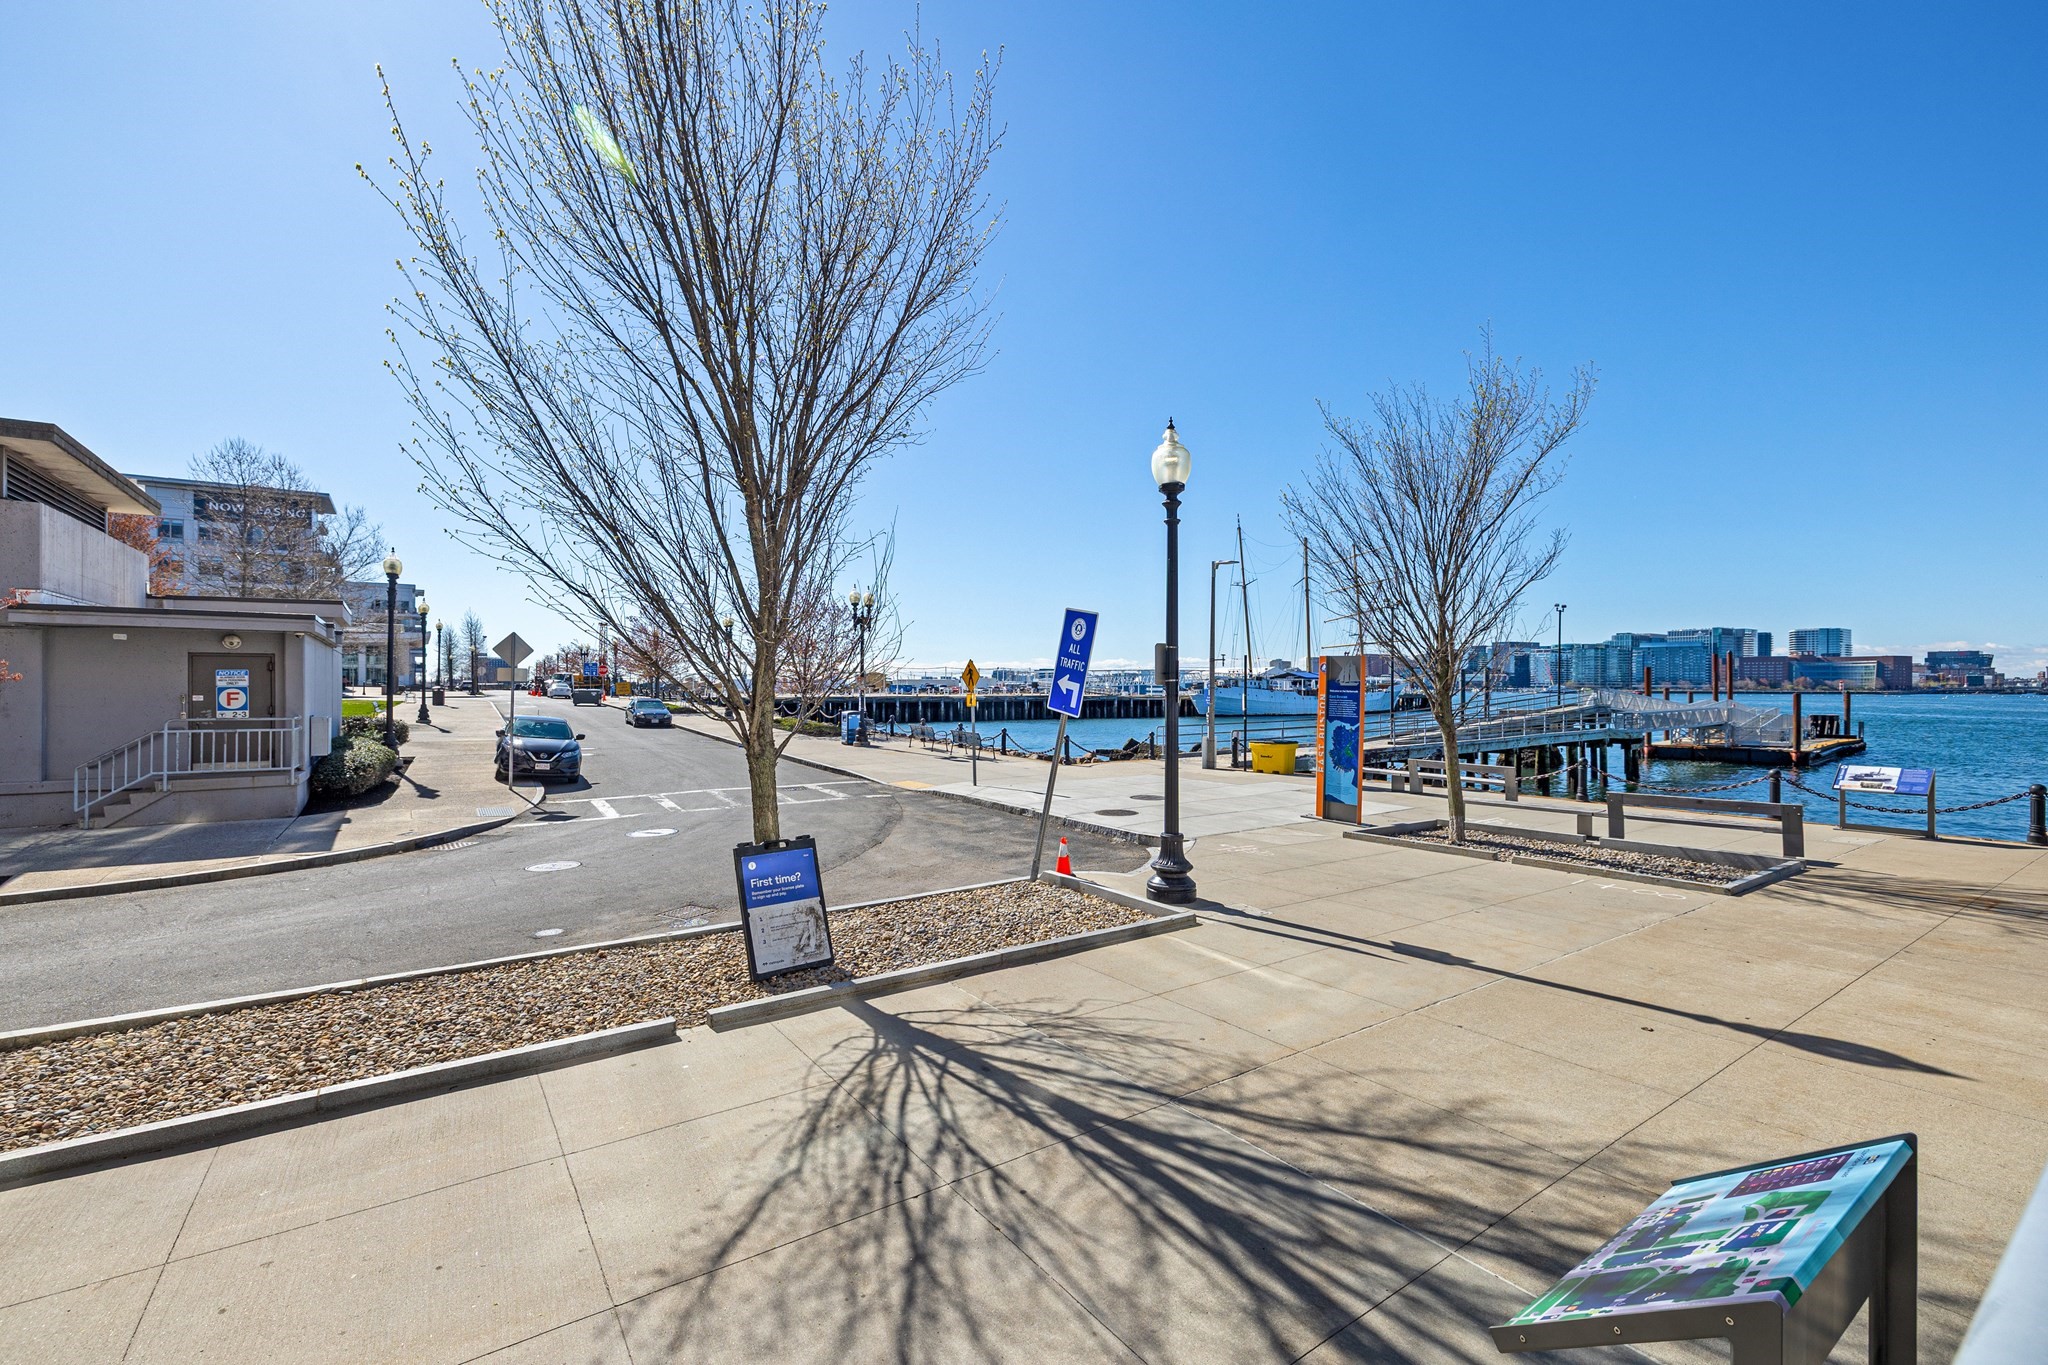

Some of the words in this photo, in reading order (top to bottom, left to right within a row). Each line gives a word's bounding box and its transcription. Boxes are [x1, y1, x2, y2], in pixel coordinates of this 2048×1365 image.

[209, 501, 244, 513] NOW
[251, 506, 305, 518] EASNG
[1068, 643, 1081, 655] ALL
[1060, 656, 1086, 672] TRAFFIC
[226, 692, 240, 706] F
[1317, 743, 1325, 772] EAST
[750, 877, 773, 888] First
[775, 872, 801, 884] time?
